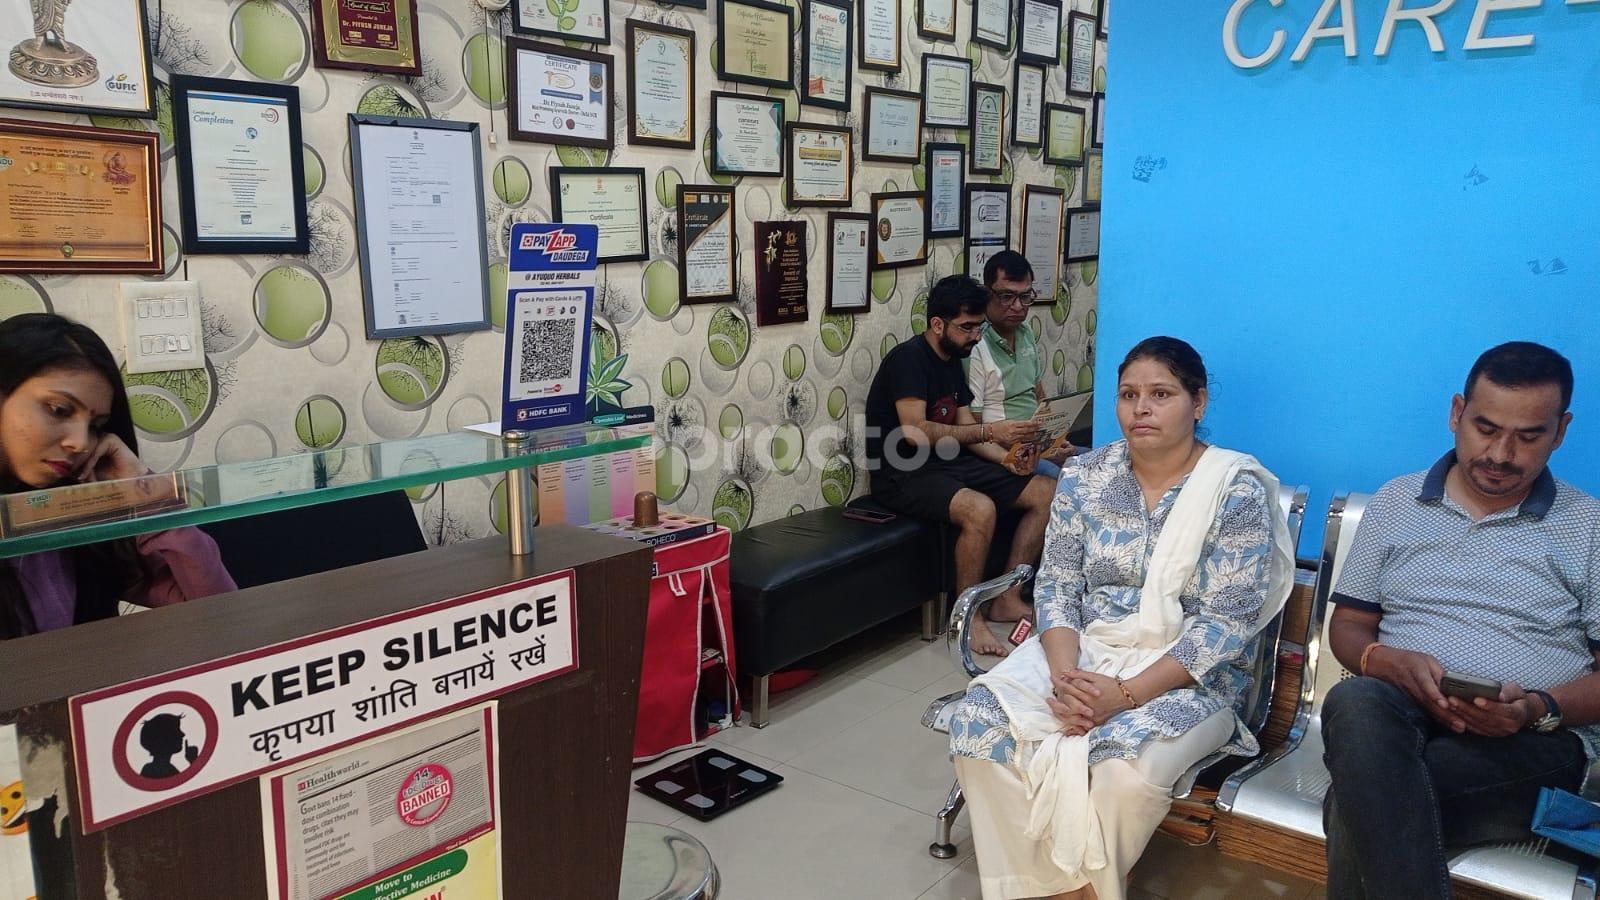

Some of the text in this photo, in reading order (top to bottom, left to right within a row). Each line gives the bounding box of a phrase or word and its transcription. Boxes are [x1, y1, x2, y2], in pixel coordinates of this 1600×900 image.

[1222, 0, 1542, 68] CARE
[545, 60, 578, 71] CERTIFICATE
[108, 81, 137, 91] GUFIC
[193, 114, 234, 125] Completion
[552, 251, 587, 262] DAUDEGA
[556, 272, 580, 280] HERBALS
[529, 406, 568, 417] HDFC BANK
[231, 594, 558, 717] KEEP SILENCE
[249, 633, 548, 762] कृपया शांति बनायें रखें
[415, 769, 429, 781] 14
[402, 782, 449, 813] BANNED
[375, 873, 413, 894] Move to
[410, 868, 451, 891] Medicine
